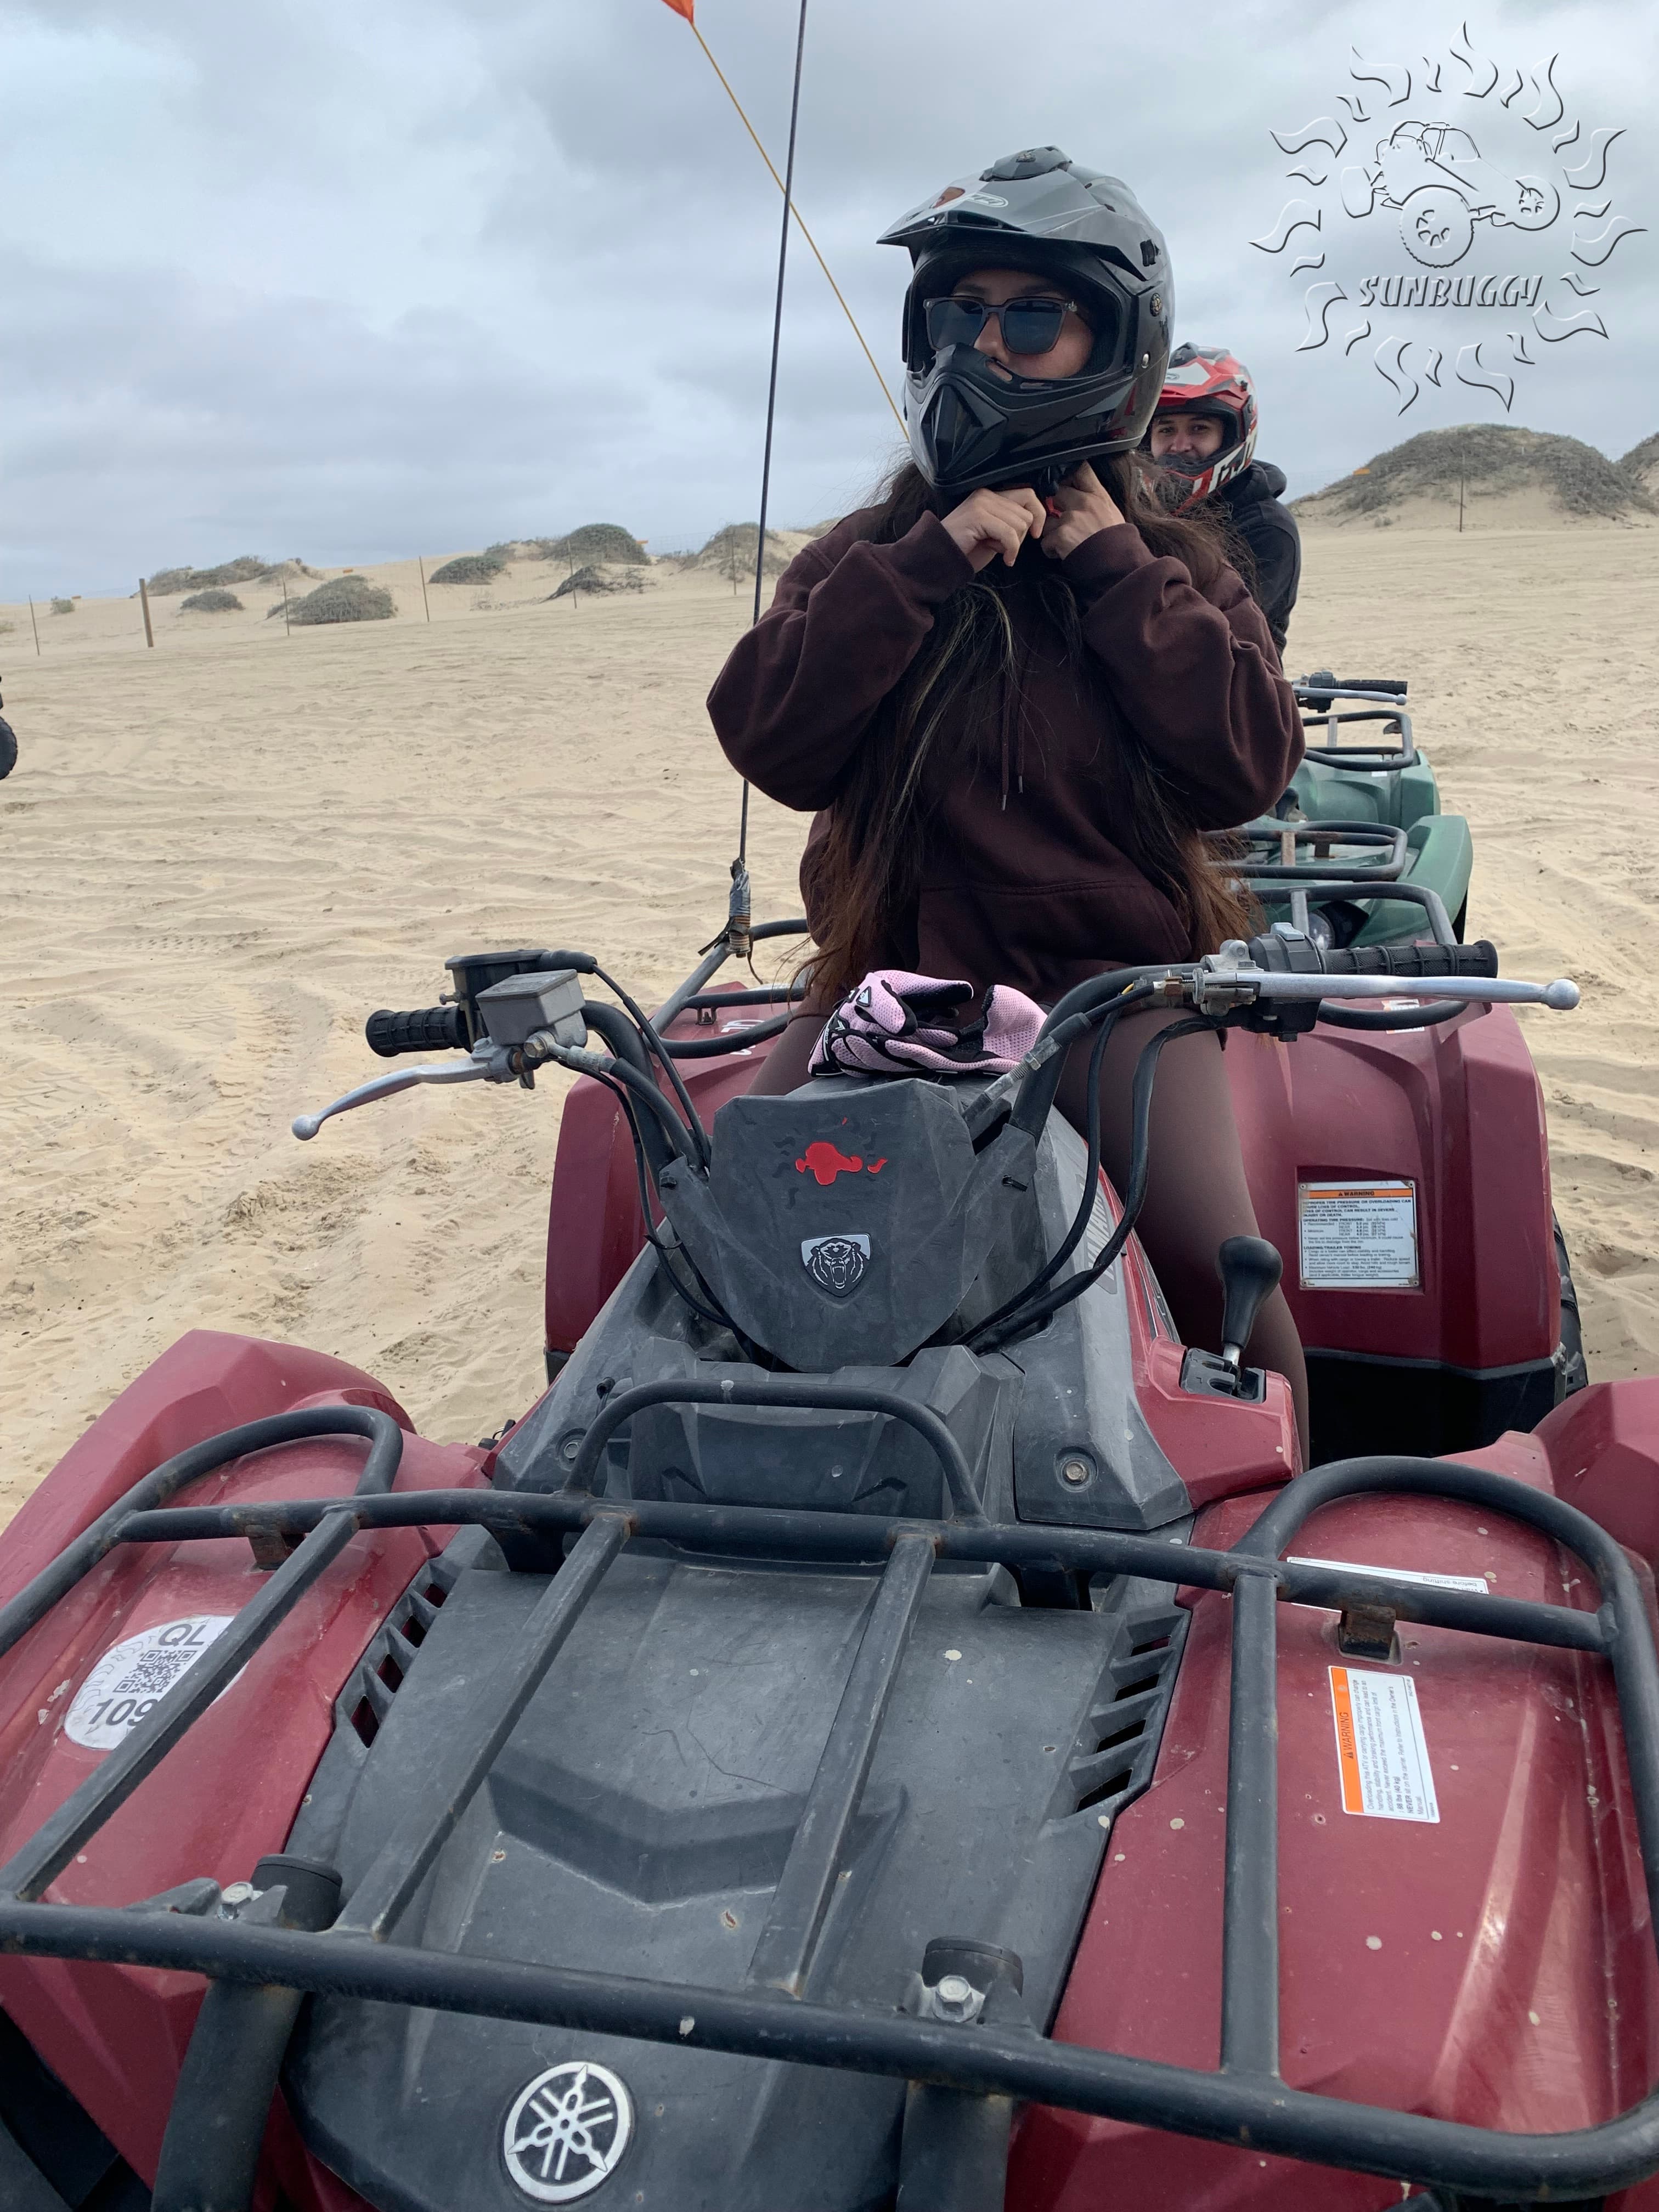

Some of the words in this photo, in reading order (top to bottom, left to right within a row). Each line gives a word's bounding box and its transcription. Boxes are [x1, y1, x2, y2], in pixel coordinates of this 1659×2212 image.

[157, 1624, 207, 1646] QL
[88, 1699, 159, 1726] 109
[1339, 1712, 1352, 1750] WARNING
[1405, 1795, 1413, 1813] NEVER
